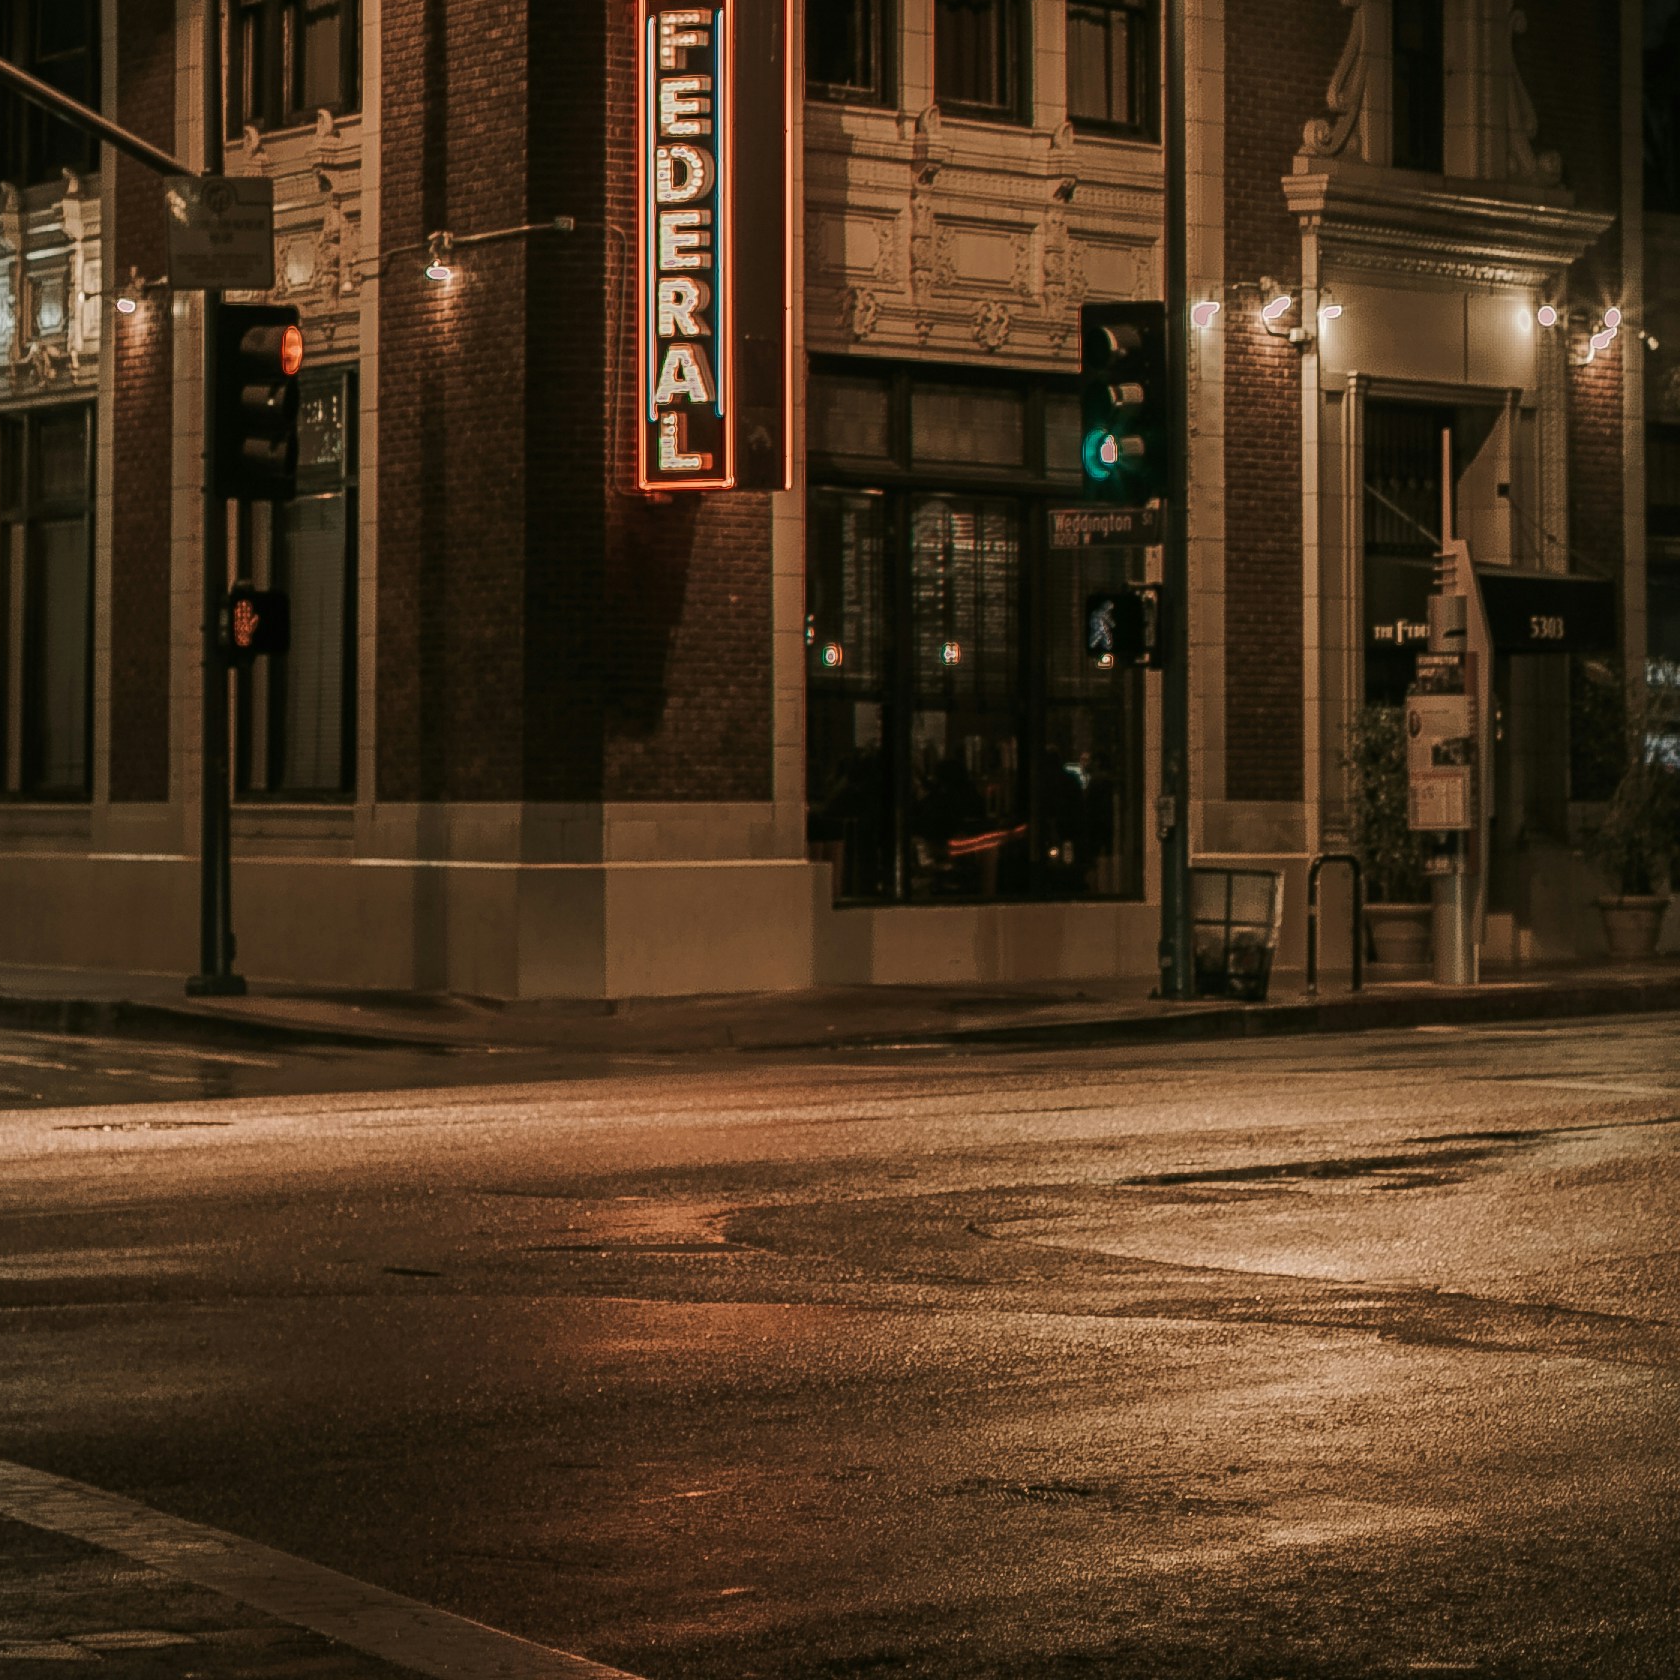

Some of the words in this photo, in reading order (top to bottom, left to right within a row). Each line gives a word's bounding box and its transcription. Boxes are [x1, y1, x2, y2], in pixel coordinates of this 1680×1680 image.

[655, 8, 717, 472] FEDERAL
[1053, 512, 1133, 538] Weddington
[1528, 614, 1565, 641] 5303
